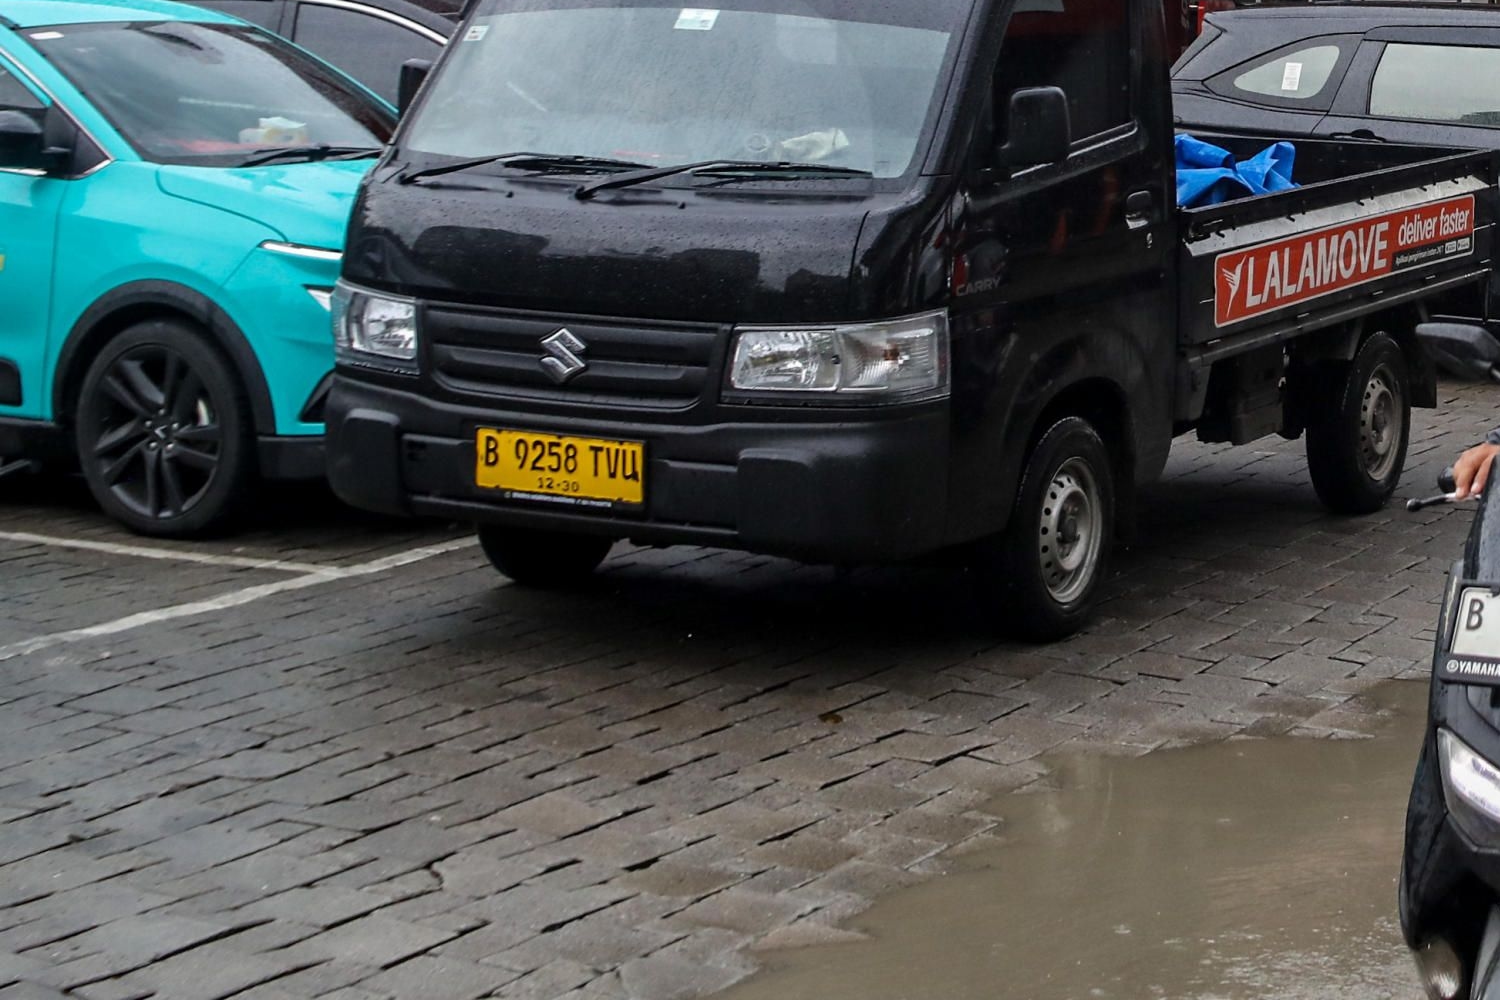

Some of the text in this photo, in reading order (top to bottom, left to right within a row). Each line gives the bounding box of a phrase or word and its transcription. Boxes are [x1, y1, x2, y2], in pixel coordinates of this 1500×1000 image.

[1398, 214, 1438, 247] deliver
[1439, 206, 1470, 238] faster
[1246, 221, 1389, 309] LALAMOVE
[957, 277, 1001, 296] CARRY
[485, 436, 640, 483] B 9258 TVU
[1466, 598, 1485, 631] B
